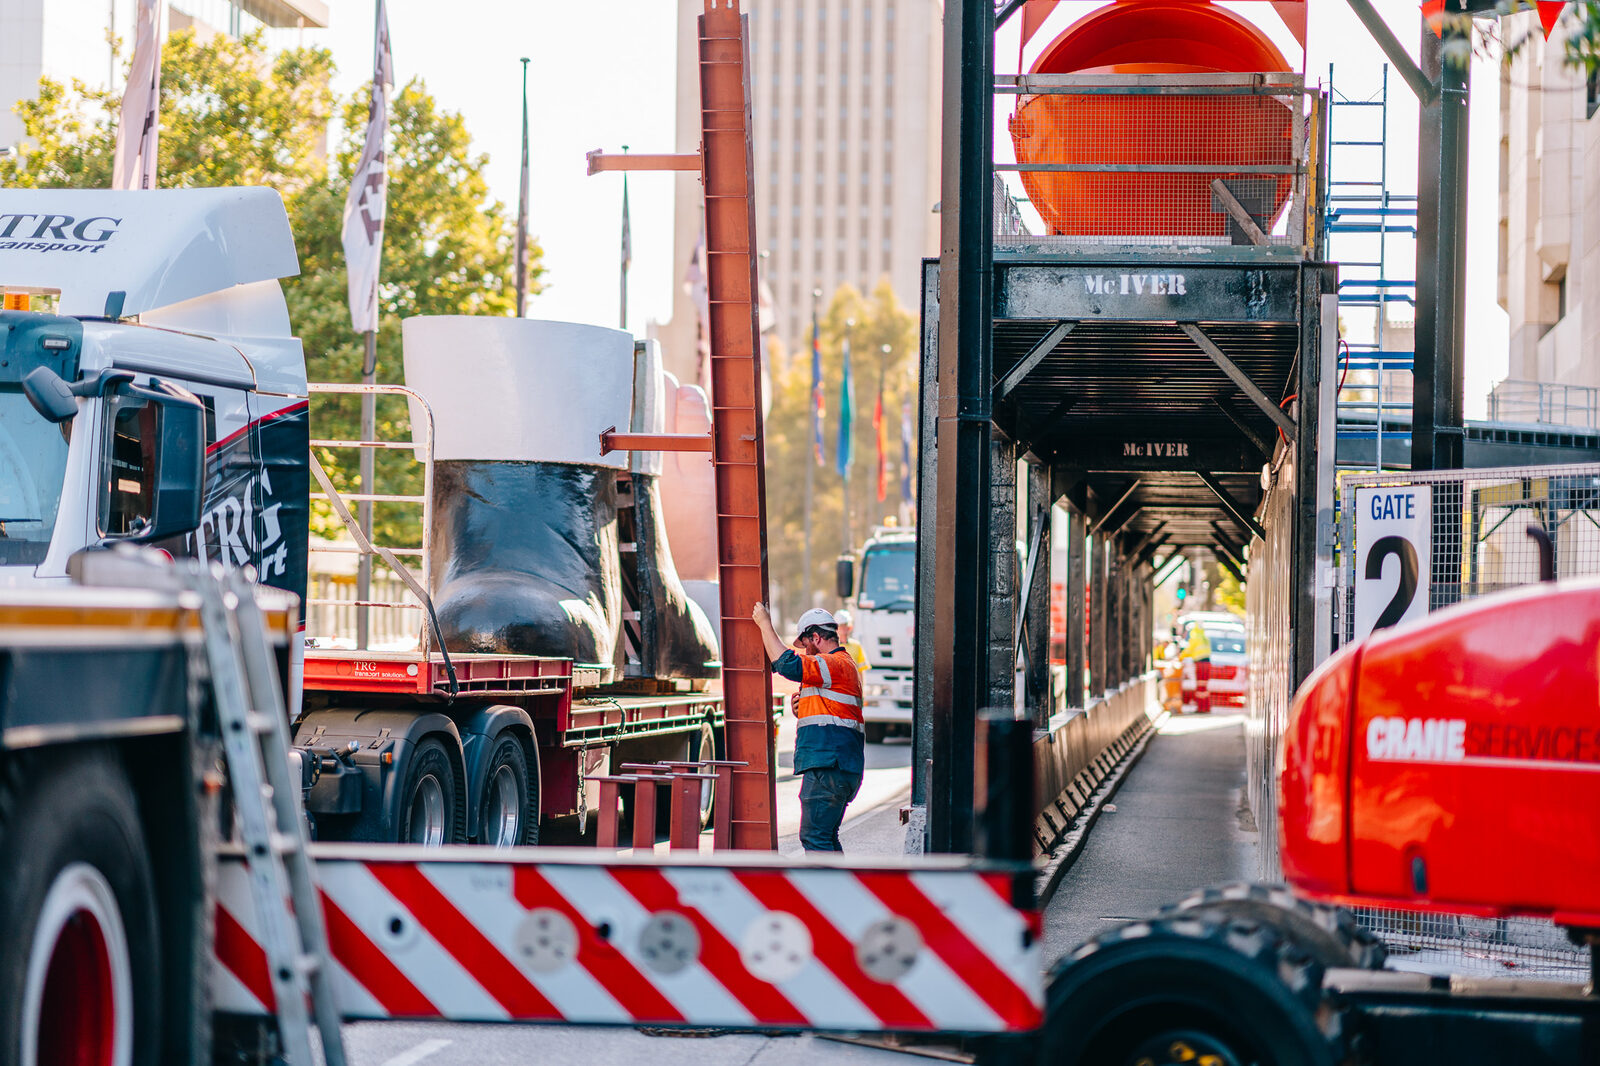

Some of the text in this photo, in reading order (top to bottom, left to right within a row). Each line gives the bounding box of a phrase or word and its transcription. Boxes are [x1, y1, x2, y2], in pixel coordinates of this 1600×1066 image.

[0, 214, 123, 242] TRG
[0, 241, 106, 253] ansport
[185, 468, 282, 571] TRG
[1371, 494, 1416, 520] GATE
[1365, 535, 1419, 636] 2
[353, 661, 377, 671] TRG
[1367, 716, 1467, 762] CRANE
